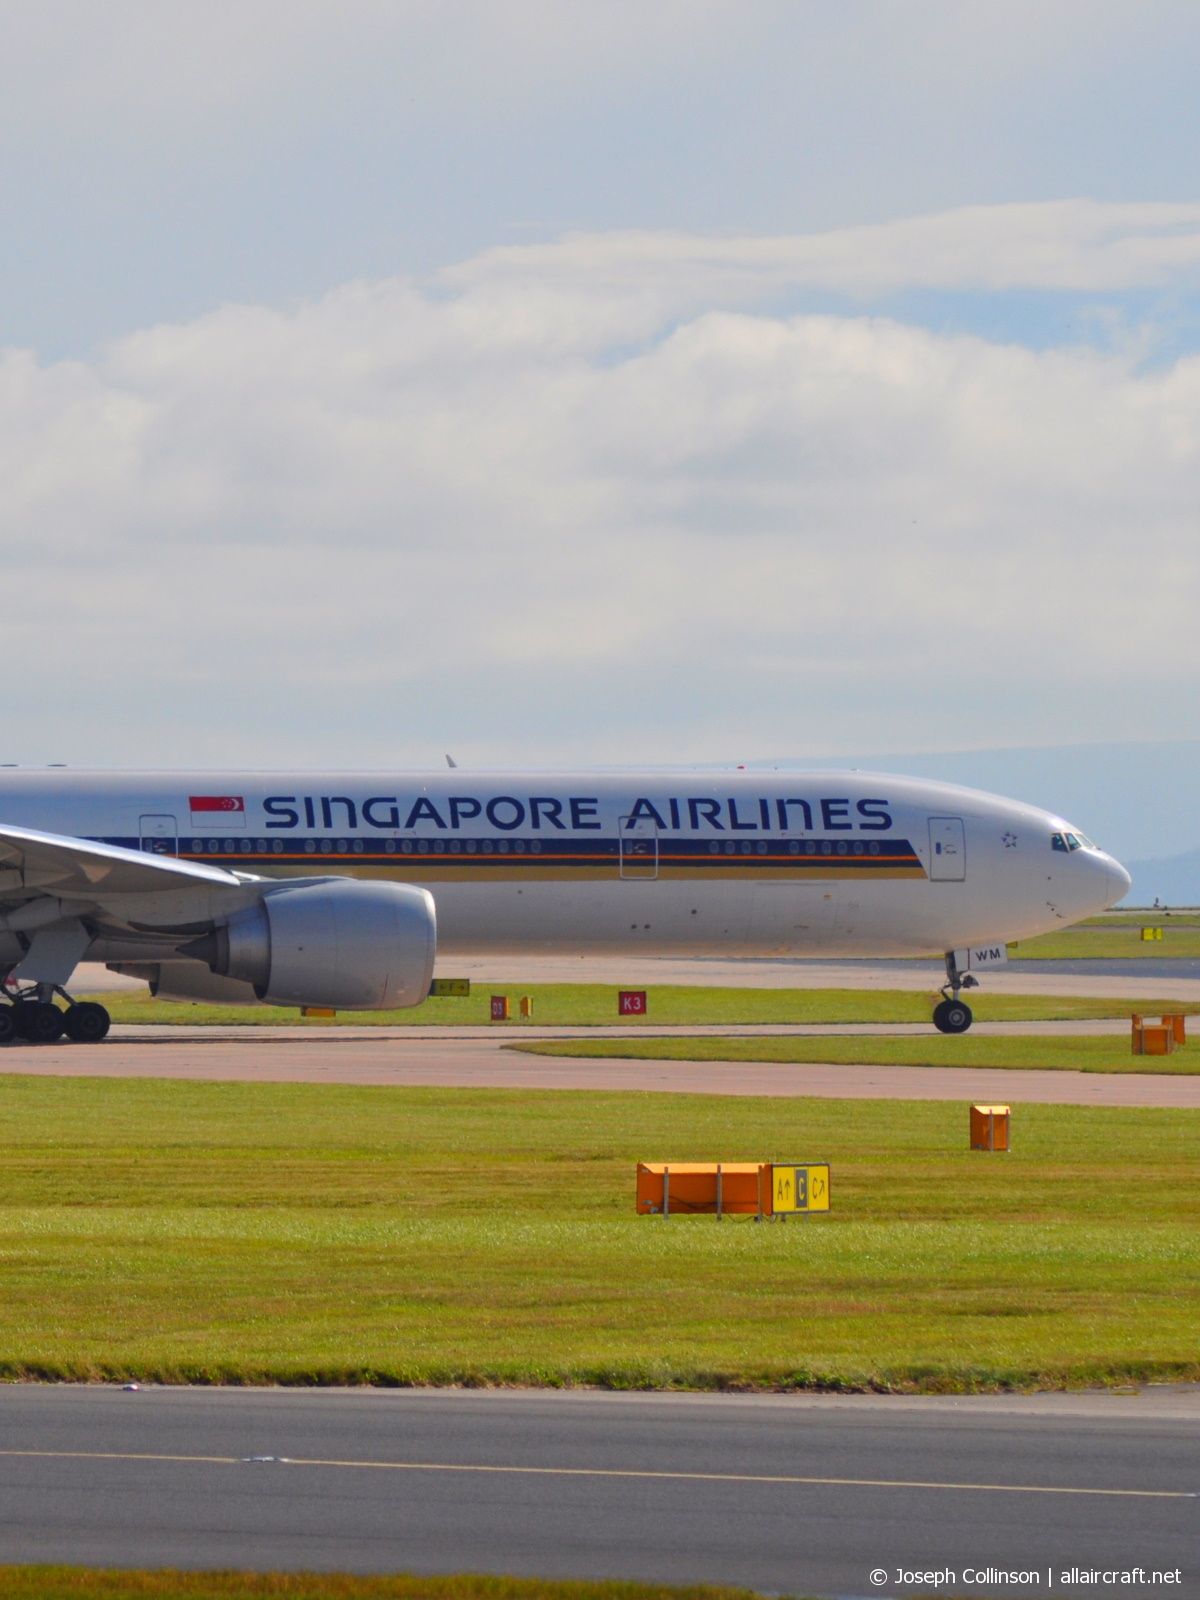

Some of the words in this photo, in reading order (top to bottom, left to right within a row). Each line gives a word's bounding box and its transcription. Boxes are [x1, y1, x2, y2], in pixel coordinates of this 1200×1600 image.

[263, 796, 601, 830] SINGAPORE
[625, 797, 893, 831] AIRLINES
[975, 948, 1001, 962] WM
[624, 997, 641, 1010] K3
[777, 1178, 784, 1200] A
[799, 1177, 805, 1200] C
[812, 1176, 818, 1200] C
